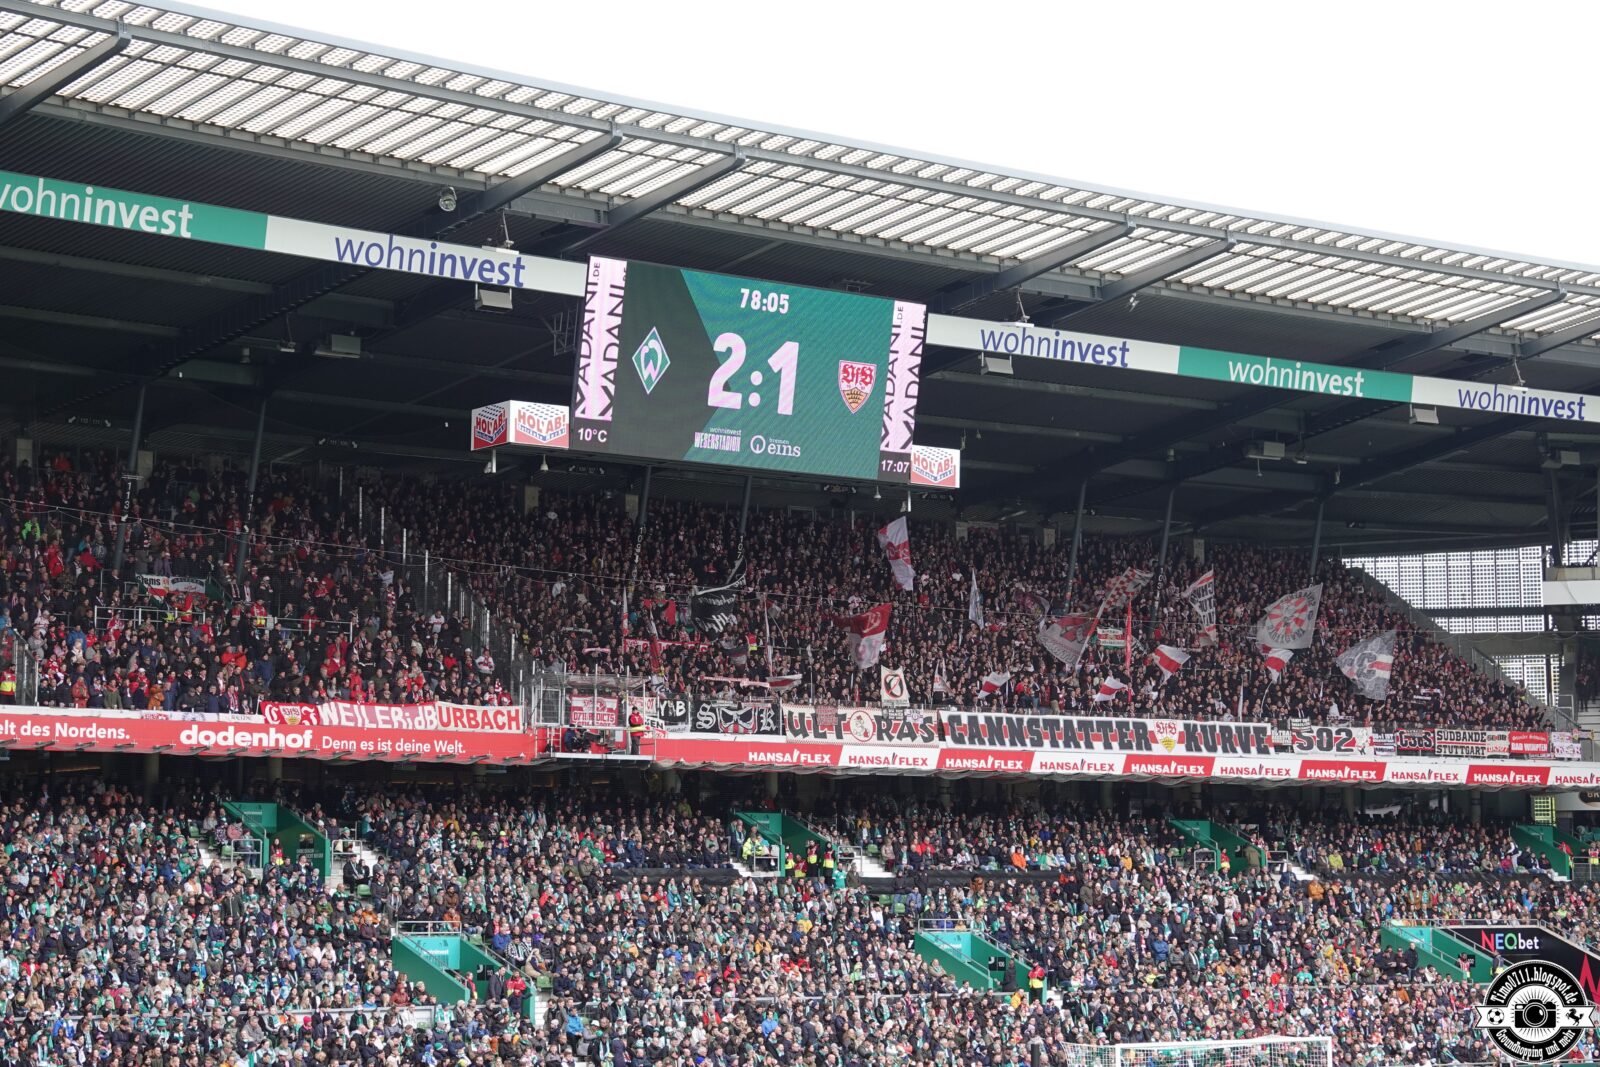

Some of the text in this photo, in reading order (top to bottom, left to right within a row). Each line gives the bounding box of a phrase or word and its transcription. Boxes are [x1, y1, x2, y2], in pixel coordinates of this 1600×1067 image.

[335, 234, 525, 288] wohninvest
[740, 288, 790, 315] 78:05
[980, 325, 1129, 369] wohninvest
[707, 332, 800, 416] 2:1
[1228, 357, 1364, 398] wohninvest
[1459, 383, 1586, 422] wohninvest
[517, 409, 567, 434] HOL'AB!
[577, 428, 608, 443] 10°C
[694, 432, 741, 452] WESERSTADION
[767, 443, 801, 458] eins
[881, 459, 910, 473] 17:07
[913, 453, 954, 475] HOL'AB!
[20, 720, 51, 737] des
[55, 722, 131, 740] Nordens.
[180, 724, 313, 748] dodenhof
[948, 713, 1153, 751] CANNSTATTER
[1183, 722, 1271, 755] KURVE
[322, 735, 466, 754] Denn es ist deine Welt.
[1436, 744, 1487, 756] STUTTGART
[749, 752, 831, 764] HANSA FLEX
[849, 755, 928, 767] HANSA FLEX
[946, 758, 1023, 769] HANSA FLEX
[1039, 761, 1115, 772] HANSA FLEX
[1131, 763, 1205, 774] HANSA FLEX
[1220, 766, 1291, 777] HANSA FLEX
[1306, 769, 1377, 779] HANSA FLEX
[1391, 771, 1459, 781] HANSA FLEX
[1474, 773, 1541, 783] HANSA FLEX
[1555, 775, 1588, 784] HANSA
